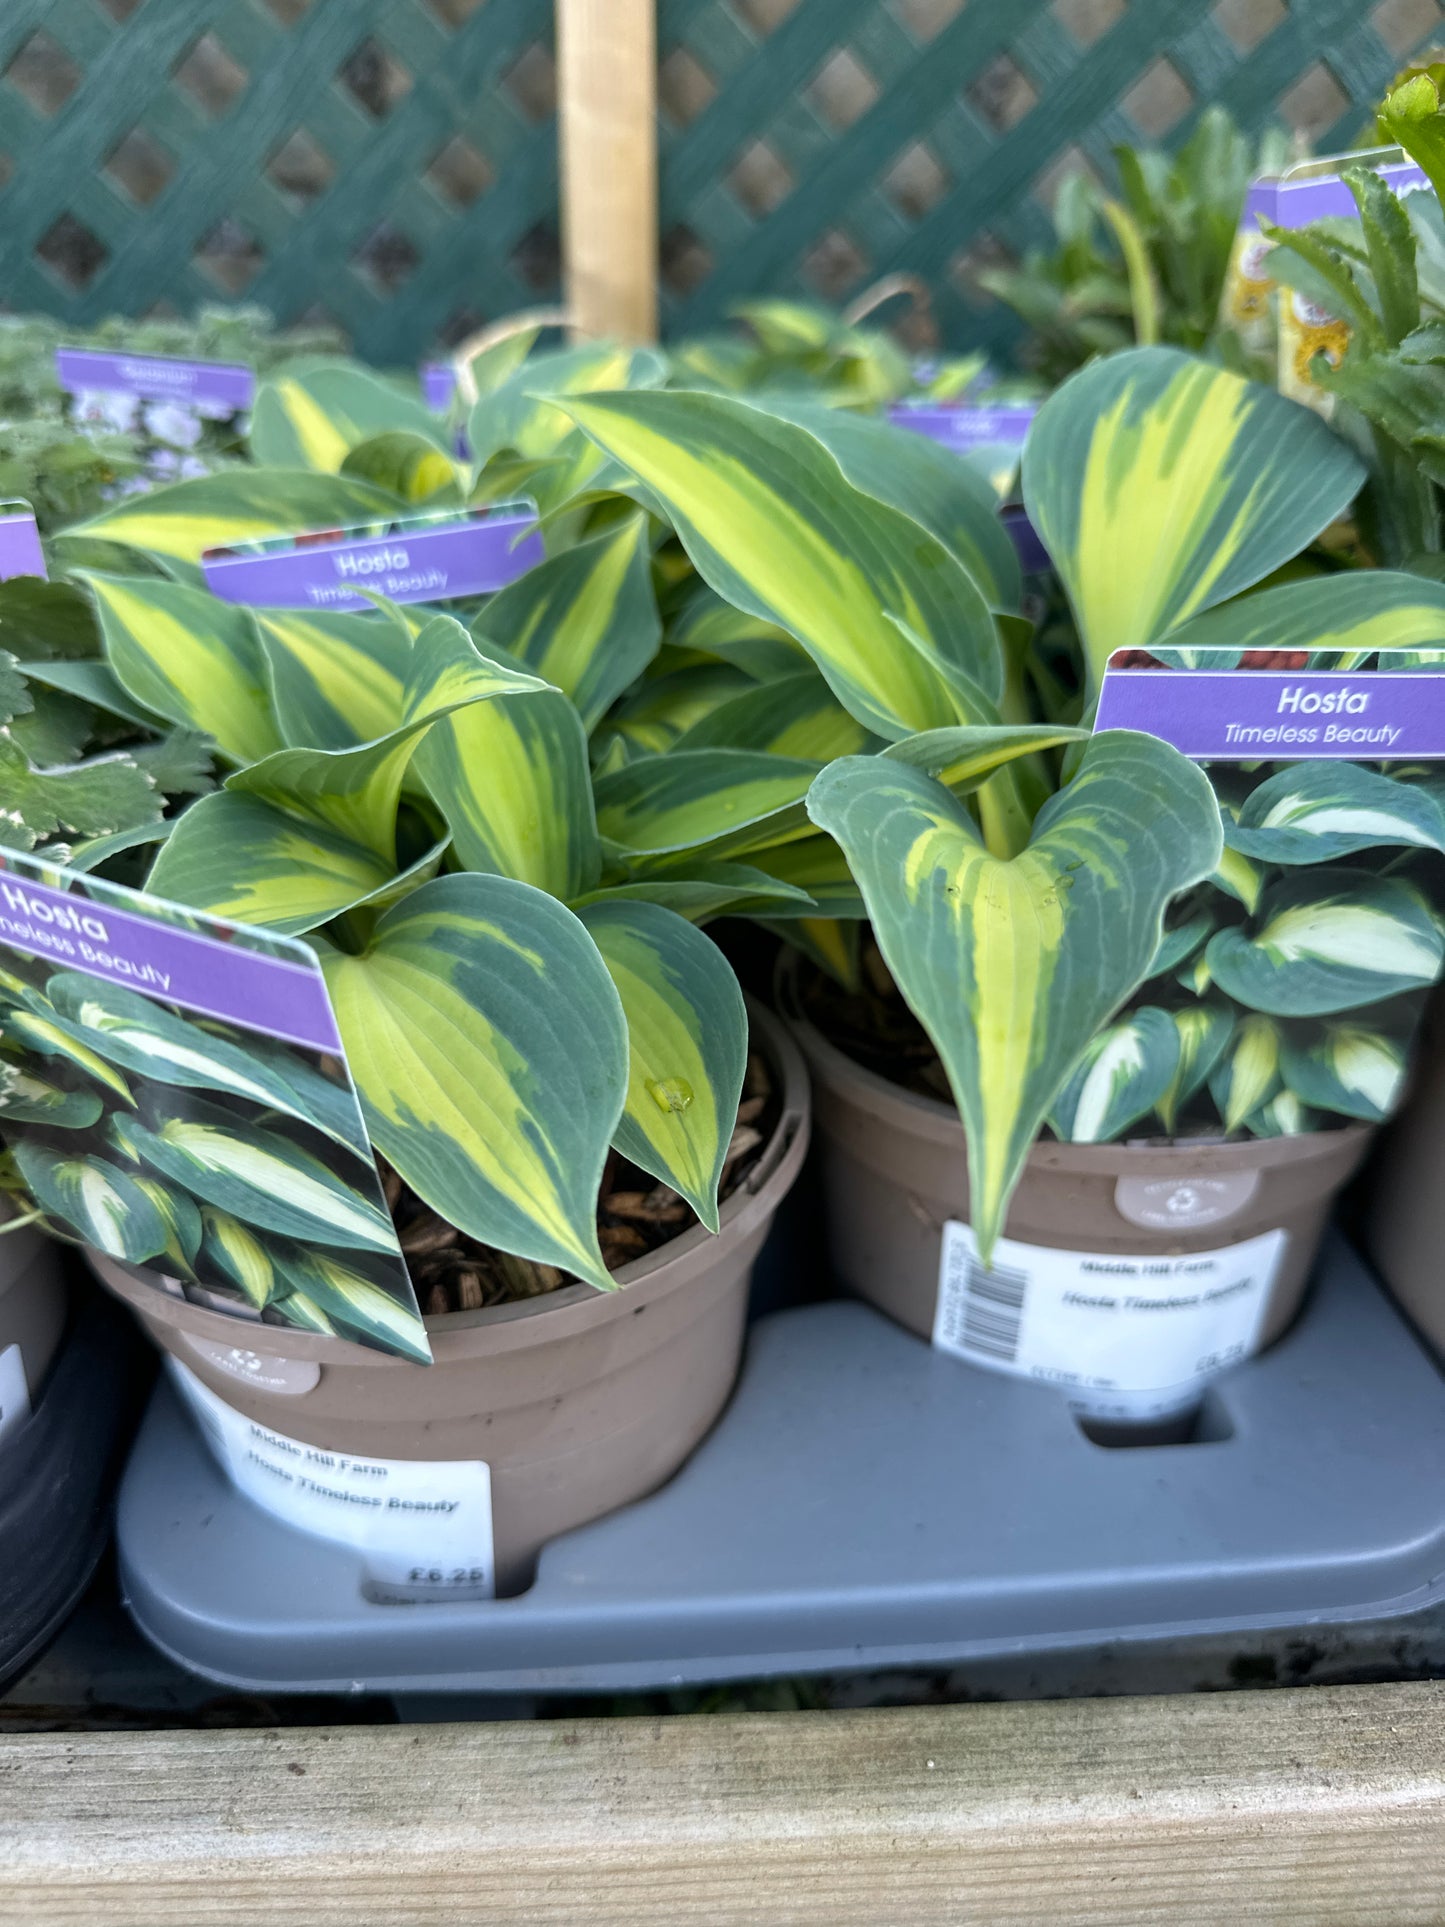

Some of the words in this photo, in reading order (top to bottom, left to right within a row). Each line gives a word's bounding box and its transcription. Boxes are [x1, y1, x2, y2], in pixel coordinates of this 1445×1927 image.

[335, 549, 410, 577] Hosta
[1277, 687, 1370, 714] Hosta
[1225, 724, 1319, 743] Timeless
[1323, 724, 1401, 746] Beauty
[1, 882, 109, 944] Hosta
[78, 940, 171, 991] Beauty
[250, 1425, 301, 1456] Middle
[307, 1449, 335, 1468] Hill
[340, 1459, 388, 1477] Farm
[299, 1475, 382, 1507] Timeless
[387, 1496, 460, 1513] Beauty
[409, 1567, 484, 1582] £6.25
